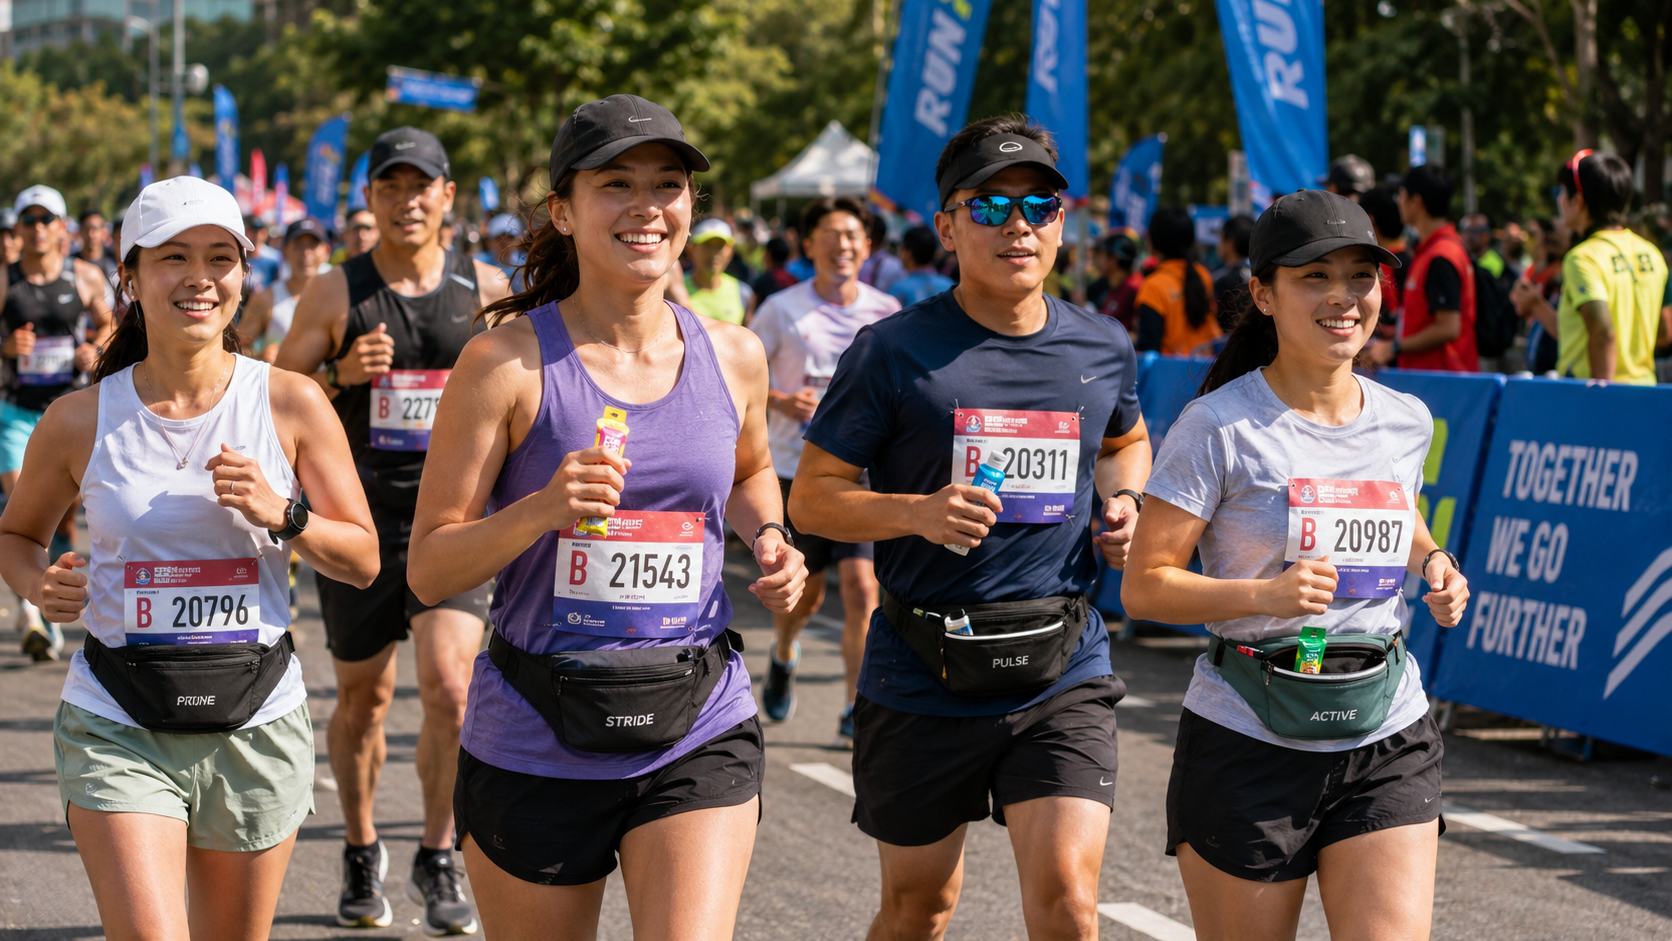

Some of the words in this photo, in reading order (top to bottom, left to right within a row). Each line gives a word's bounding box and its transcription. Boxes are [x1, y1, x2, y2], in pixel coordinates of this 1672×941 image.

[913, 7, 967, 137] RUN
[378, 396, 390, 419] B
[965, 445, 981, 477] B
[1001, 447, 1068, 480] 20311
[1501, 439, 1639, 512] TOGETHER
[1299, 517, 1317, 551] B
[1334, 518, 1403, 553] 20987
[1485, 515, 1531, 577] WE
[1526, 522, 1569, 584] GO
[569, 550, 588, 586] B
[609, 552, 691, 589] 21543
[136, 597, 152, 628] B
[172, 594, 249, 628] 20796
[1466, 590, 1587, 670] FURTHER
[992, 655, 1028, 668] PULSE
[605, 713, 654, 727] STRIDE
[1310, 708, 1358, 723] ACTIVE
